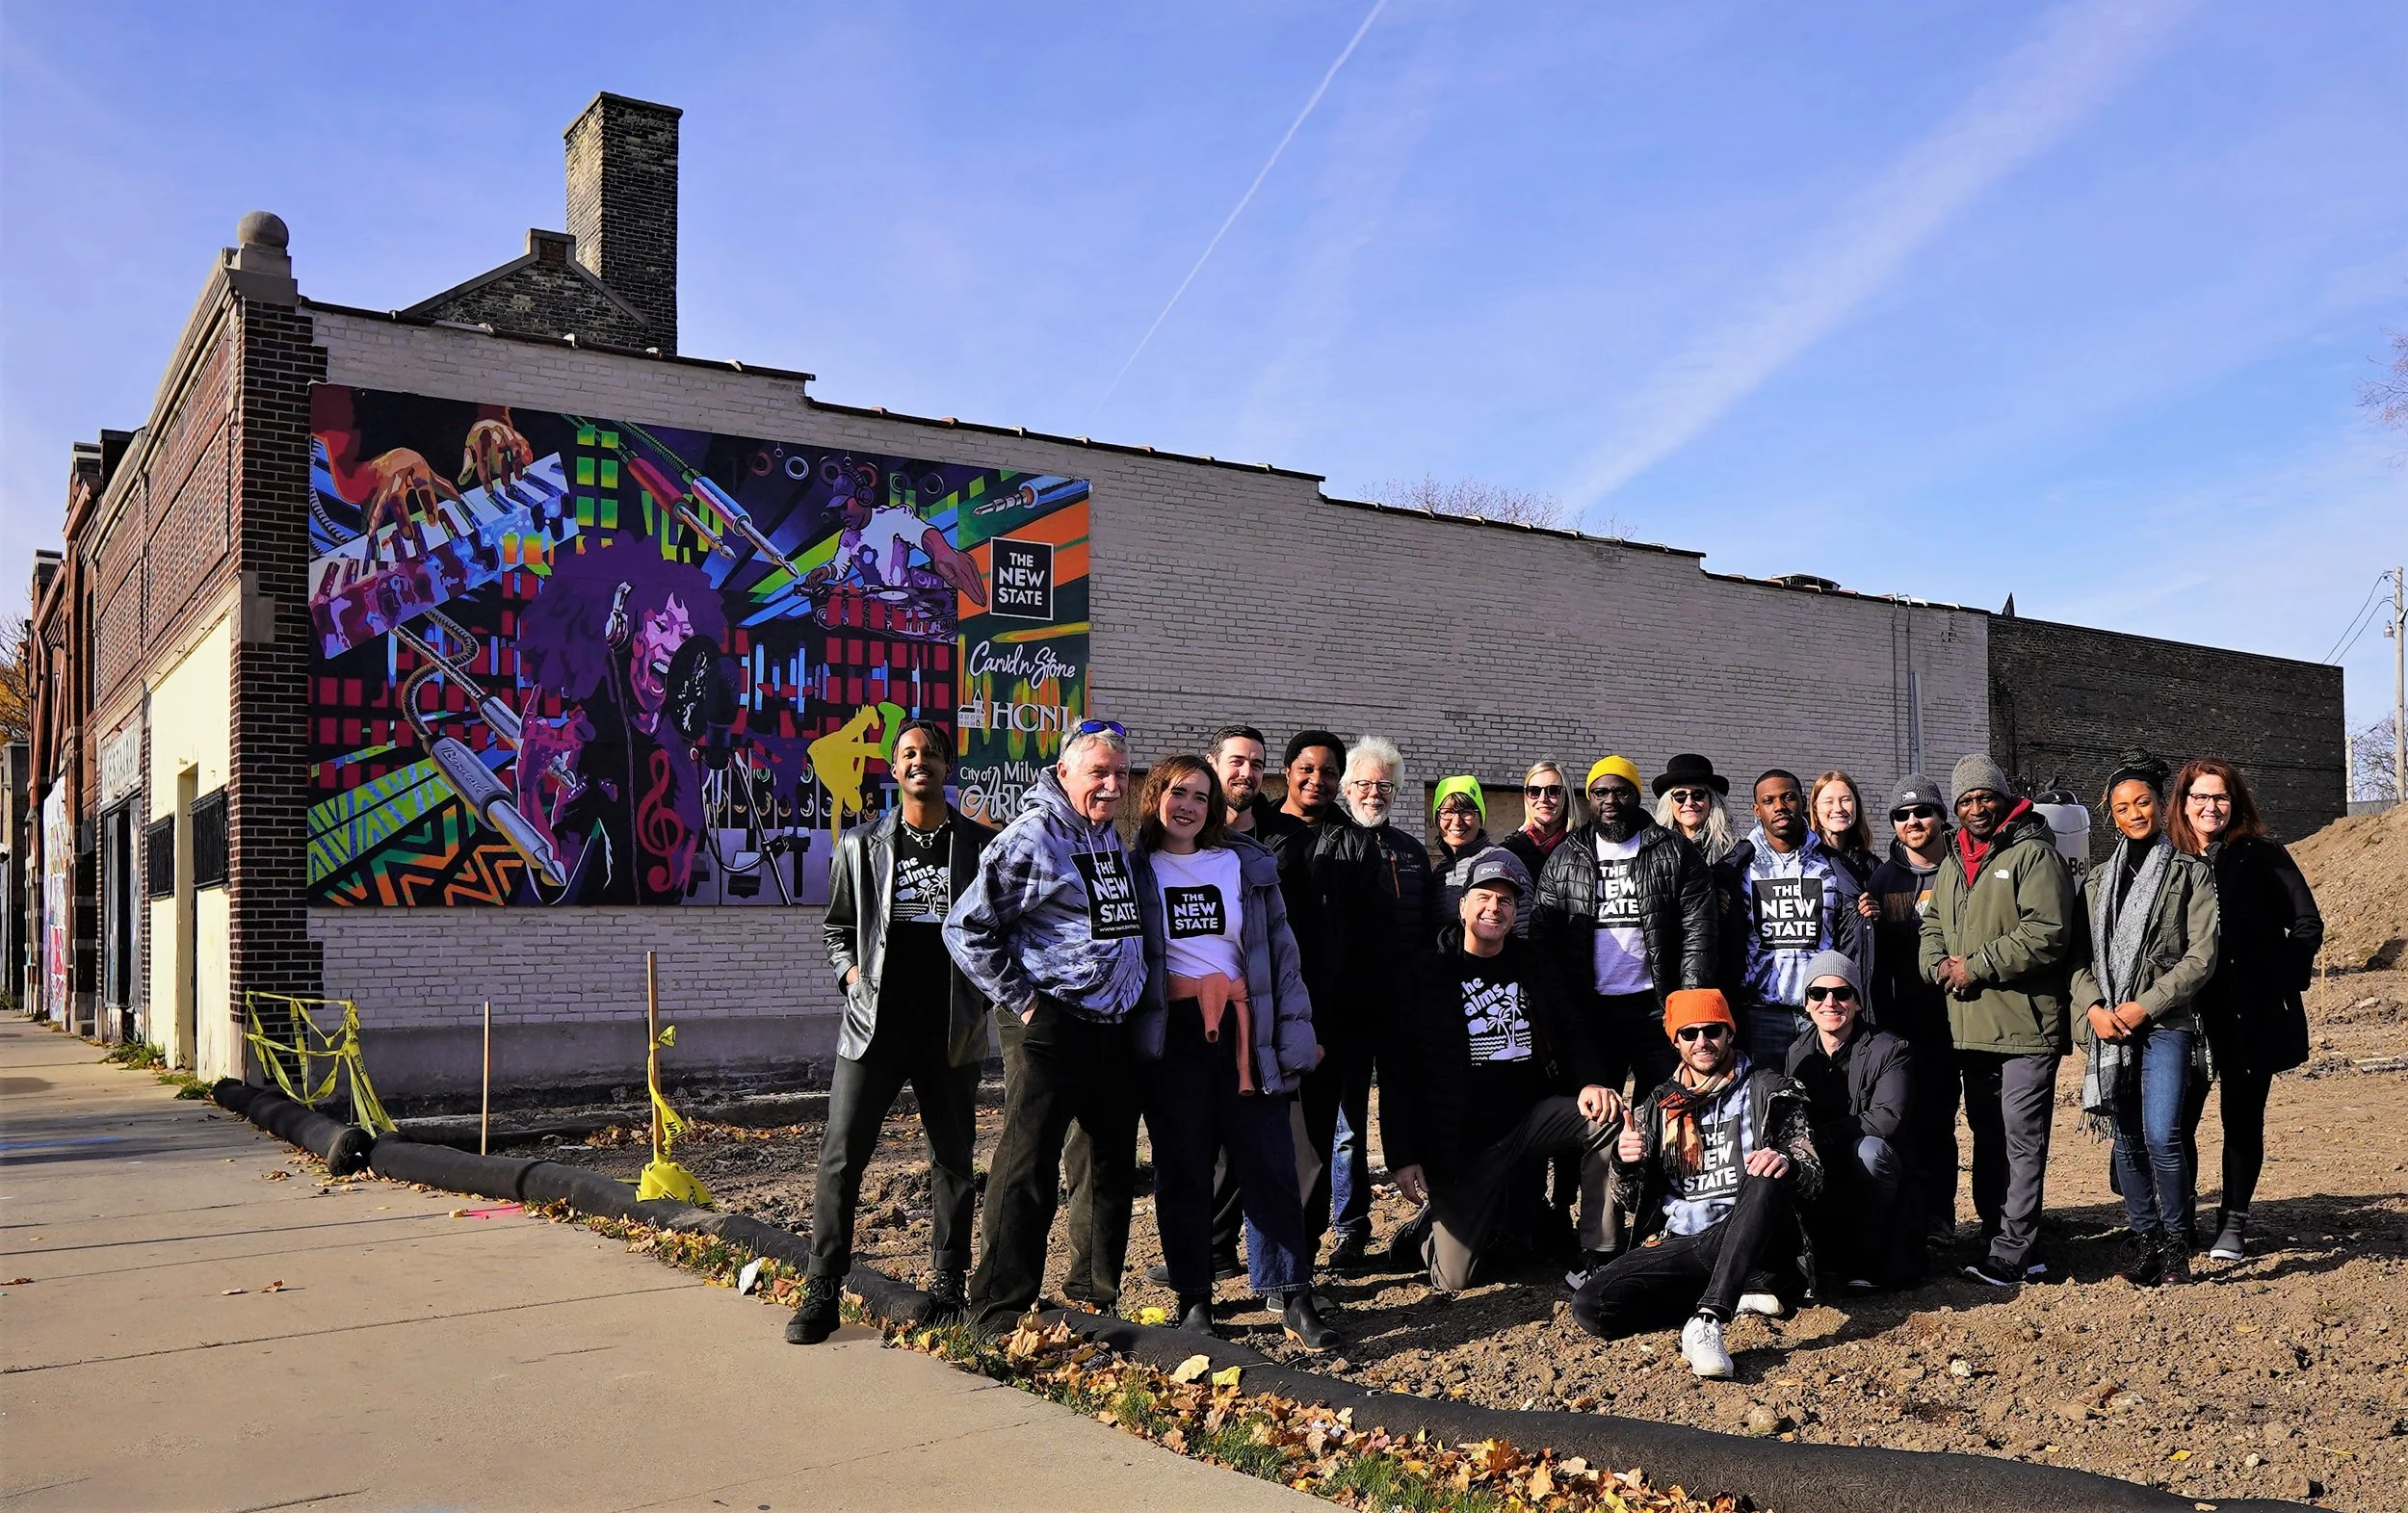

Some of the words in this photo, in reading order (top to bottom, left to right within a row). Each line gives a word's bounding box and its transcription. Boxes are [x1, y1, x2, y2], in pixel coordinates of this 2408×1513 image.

[1009, 552, 1034, 566] THE
[999, 566, 1045, 587] NEW
[998, 587, 1042, 605] STATE
[1031, 646, 1077, 690] Stone
[991, 701, 1071, 733] HCNI
[959, 766, 981, 784] City
[981, 766, 993, 782] of
[1004, 761, 1039, 782] Milw
[895, 864, 936, 887] alms
[1600, 864, 1629, 878] THE
[1090, 875, 1130, 901] NEW
[1181, 894, 1206, 902] THE
[1772, 884, 1801, 898] THE
[1100, 902, 1138, 924] STATE
[1173, 901, 1217, 917] NEW
[1598, 898, 1640, 917] TATE
[1761, 898, 1817, 919] NEW
[1175, 917, 1218, 930] STATE
[1761, 921, 1817, 938] STATE
[1460, 978, 1484, 996] he
[1462, 982, 1505, 1017] alms
[1703, 1140, 1734, 1171] EW
[1684, 1165, 1738, 1193] STATE
